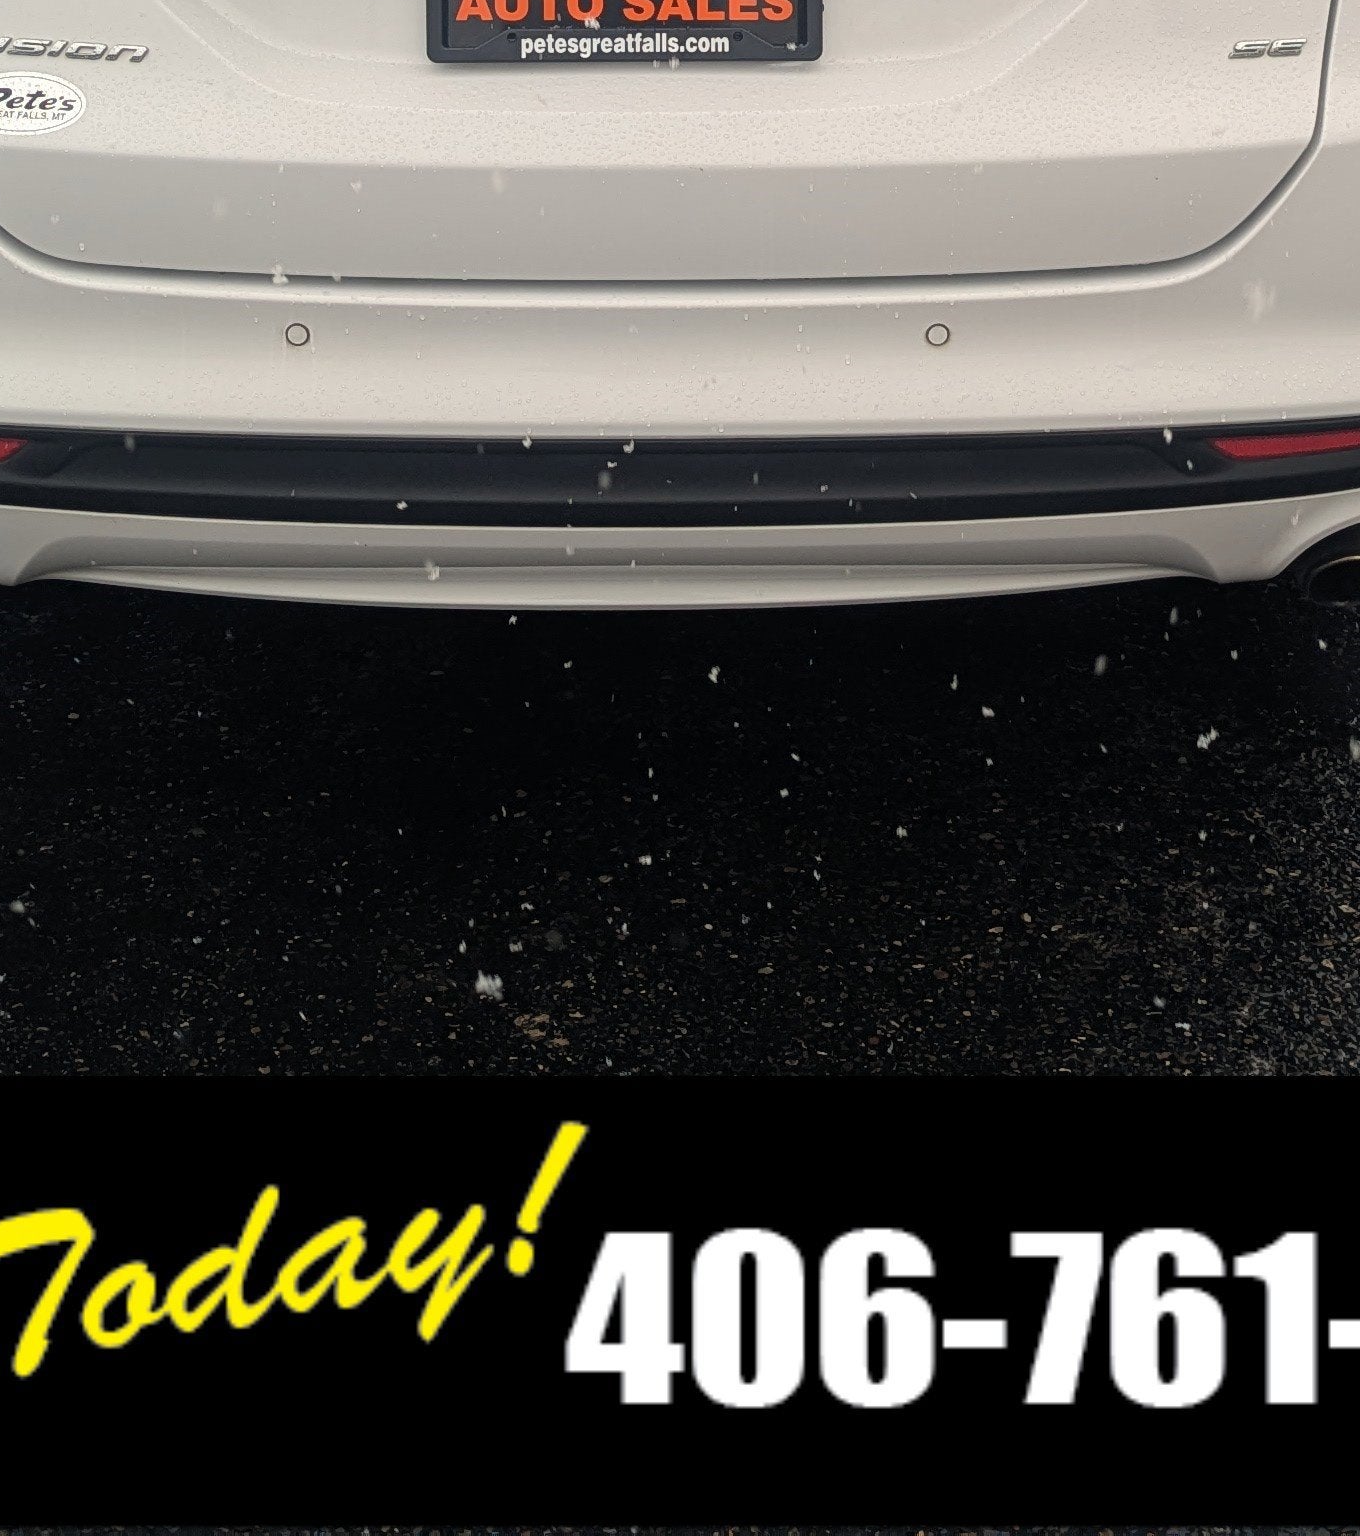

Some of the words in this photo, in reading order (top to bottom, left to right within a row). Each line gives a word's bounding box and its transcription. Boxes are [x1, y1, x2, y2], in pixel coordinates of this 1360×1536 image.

[520, 33, 730, 59] petesgreatfalls.com
[1228, 38, 1307, 60] SE
[16, 110, 49, 121] FALLS,
[51, 113, 67, 121] MT
